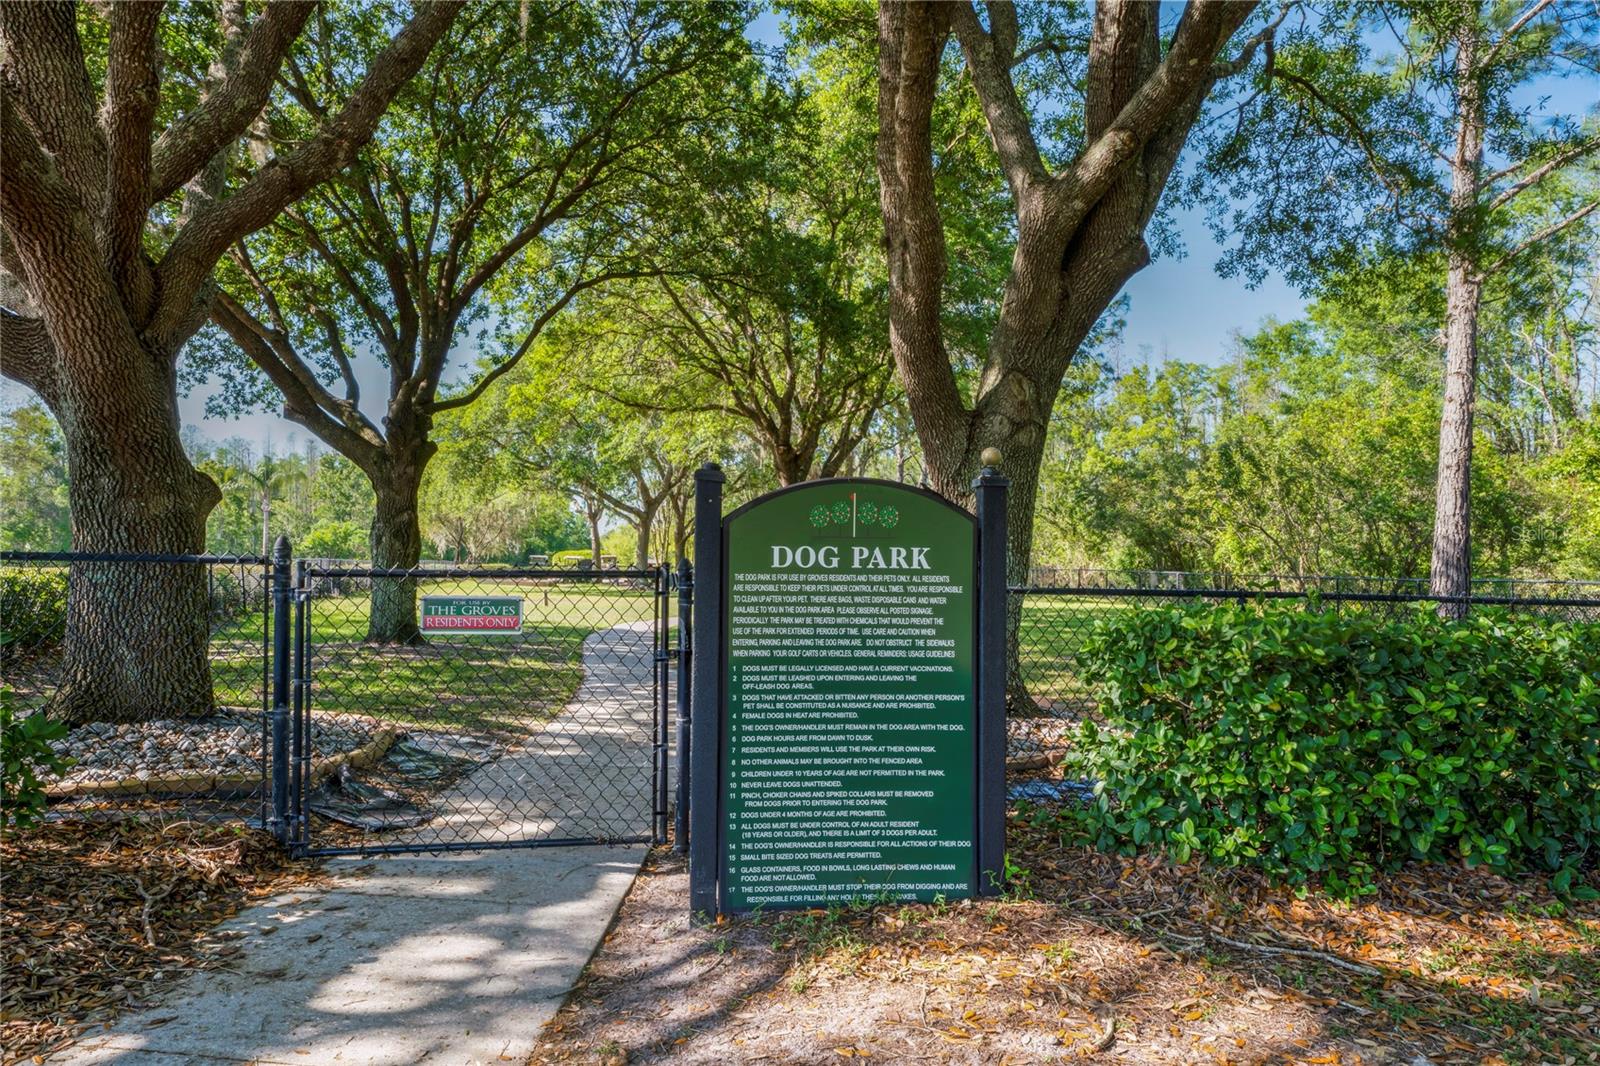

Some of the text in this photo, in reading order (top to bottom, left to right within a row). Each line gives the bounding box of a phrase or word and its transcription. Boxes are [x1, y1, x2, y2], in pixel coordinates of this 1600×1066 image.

[771, 546, 931, 569] DOG PARK
[428, 606, 515, 615] THE GROVES
[426, 618, 516, 627] RESIDENTS ONLY
